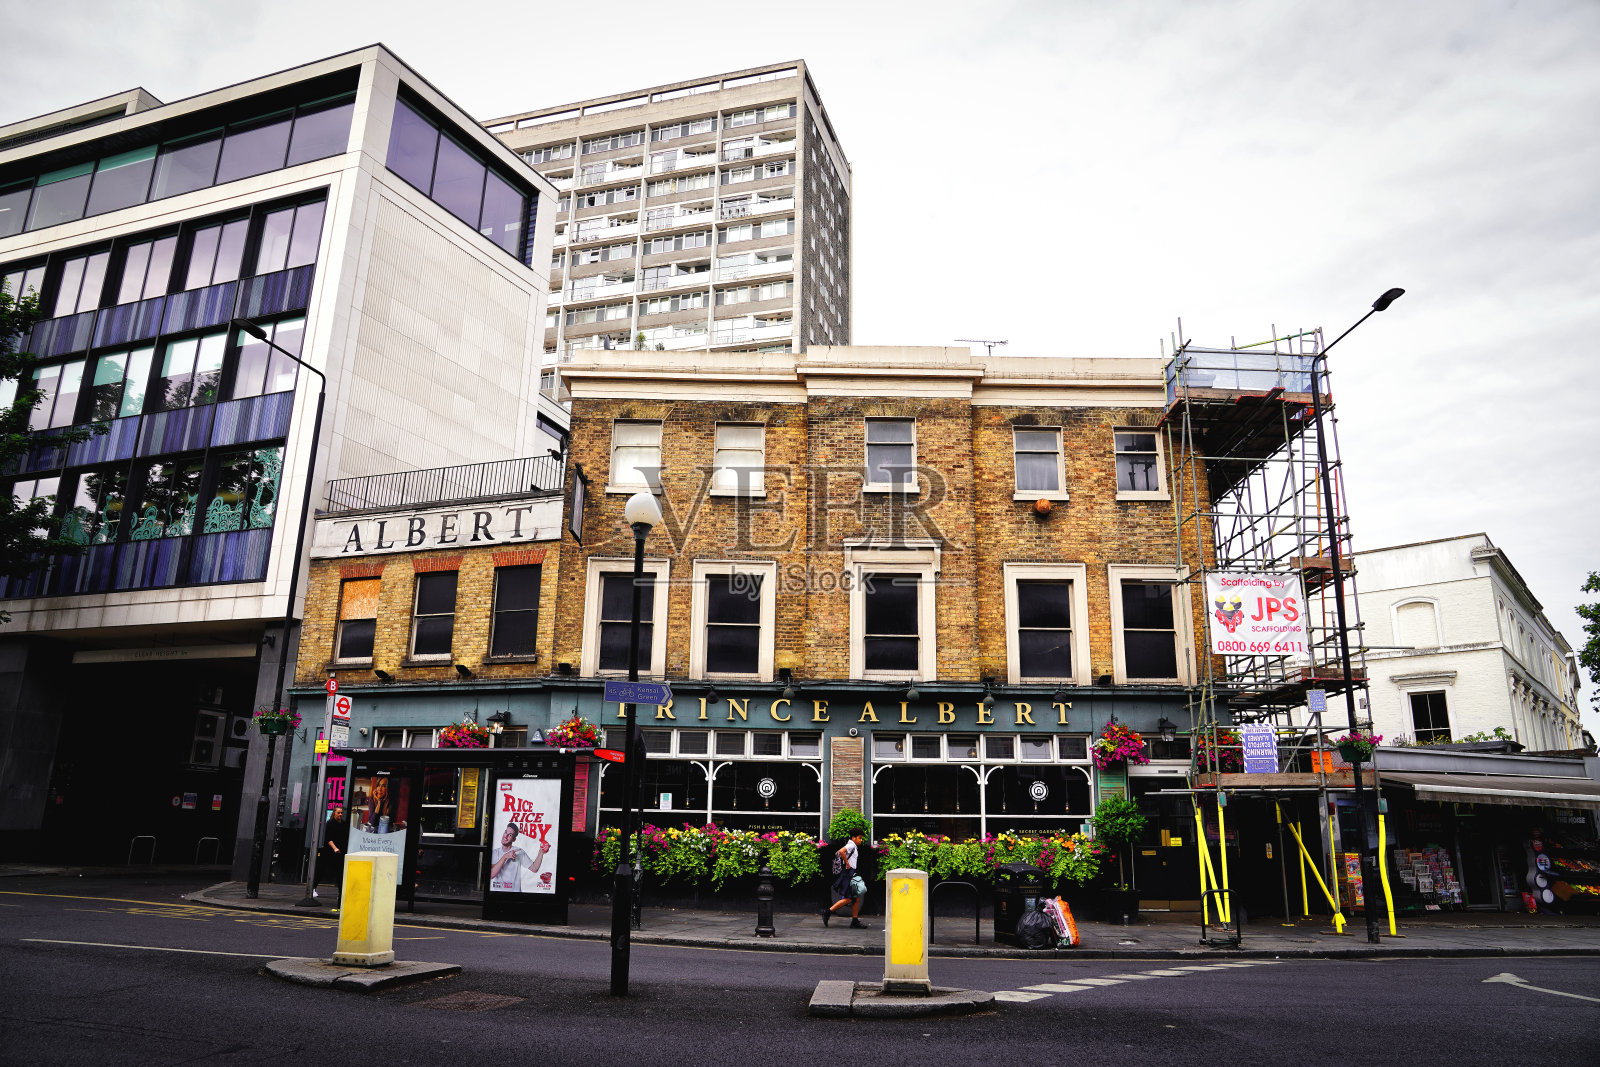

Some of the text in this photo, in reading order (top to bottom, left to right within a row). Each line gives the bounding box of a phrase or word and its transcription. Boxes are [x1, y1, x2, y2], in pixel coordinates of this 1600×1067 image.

[342, 505, 533, 553] ALBERT
[1221, 578, 1285, 588] Scaffolding by
[1251, 597, 1299, 621] JPS
[1252, 625, 1302, 633] SCAFFOLDING
[1218, 640, 1302, 653] 0800 669 6411
[330, 681, 336, 691] B
[858, 700, 1072, 725] ALBERT
[1246, 748, 1274, 756] WARNING
[502, 793, 534, 813] RICE
[509, 812, 545, 823] RICE
[519, 823, 552, 842] BABY
